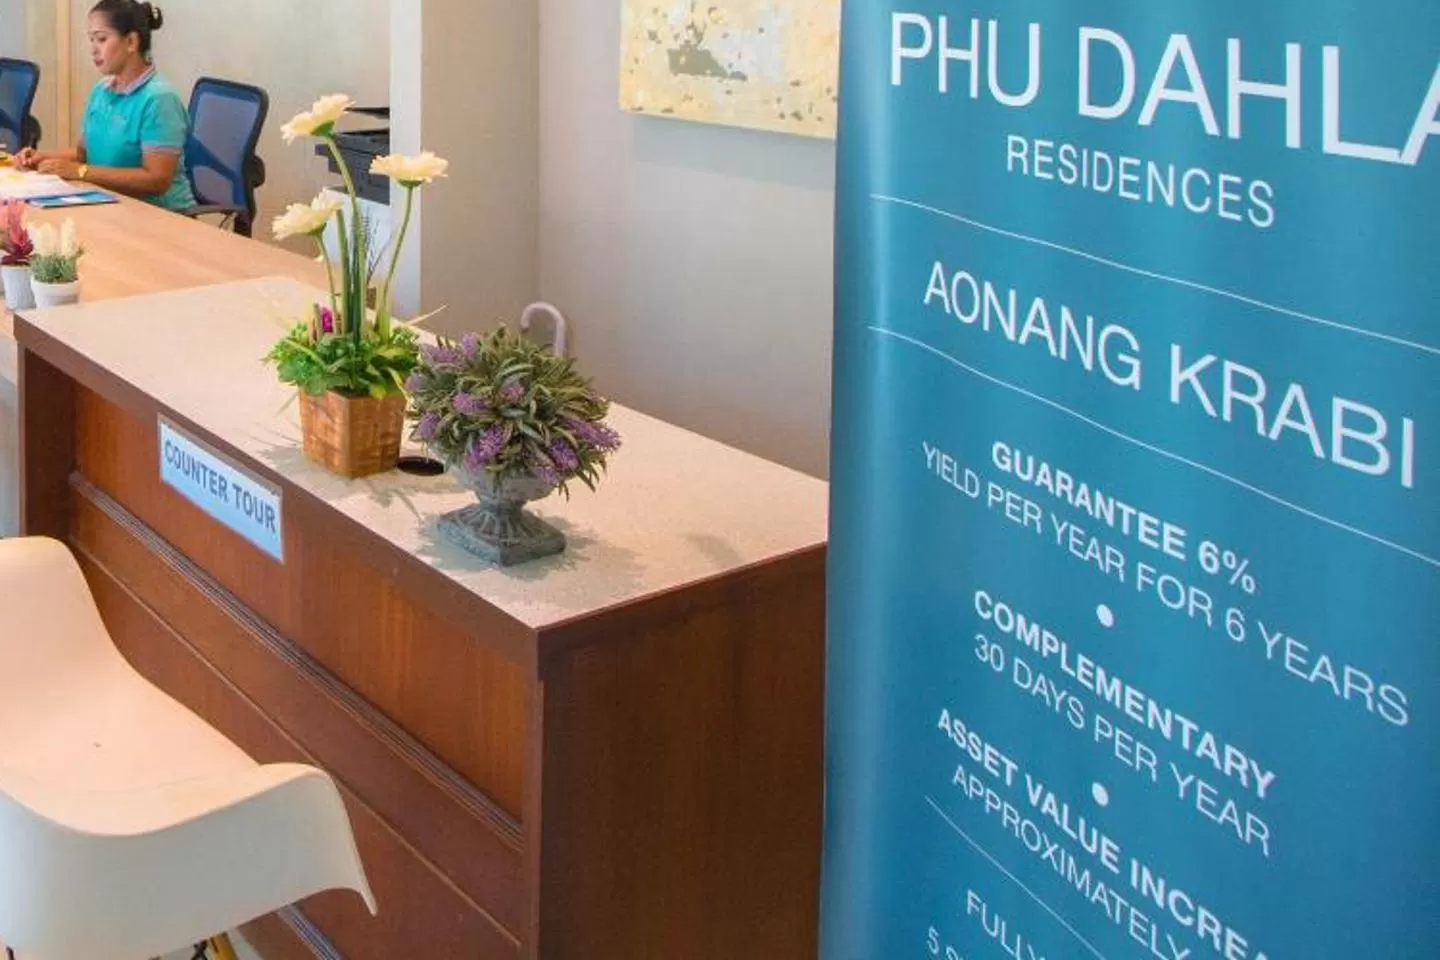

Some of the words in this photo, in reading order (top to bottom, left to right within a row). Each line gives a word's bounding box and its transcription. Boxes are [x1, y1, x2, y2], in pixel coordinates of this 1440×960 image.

[891, 11, 1040, 107] PHU
[1007, 134, 1275, 228] RESIDENCES
[923, 260, 1142, 391] AONANG
[1170, 342, 1414, 489] KRABI
[164, 439, 230, 504] COUNTER
[232, 483, 277, 534] TOUR
[922, 441, 981, 500] YIELD
[987, 481, 1043, 535] PER
[1050, 513, 1126, 583] YEAR
[1136, 561, 1213, 628] FOR
[1225, 607, 1246, 642] 6
[1257, 620, 1409, 727] YEARS
[991, 441, 1188, 560] GUARANTEE
[1197, 540, 1257, 593] 6%
[974, 590, 1277, 800] COMPLEMENTARY
[974, 633, 1006, 673] 30
[1013, 657, 1086, 730] DAYS
[1094, 713, 1158, 784] PER
[1170, 759, 1271, 859] YEAR
[938, 707, 1019, 787] ASSET
[1025, 772, 1122, 876] VALUE
[1129, 856, 1269, 960] INCRE
[952, 763, 1192, 960] APPROXIMATELY
